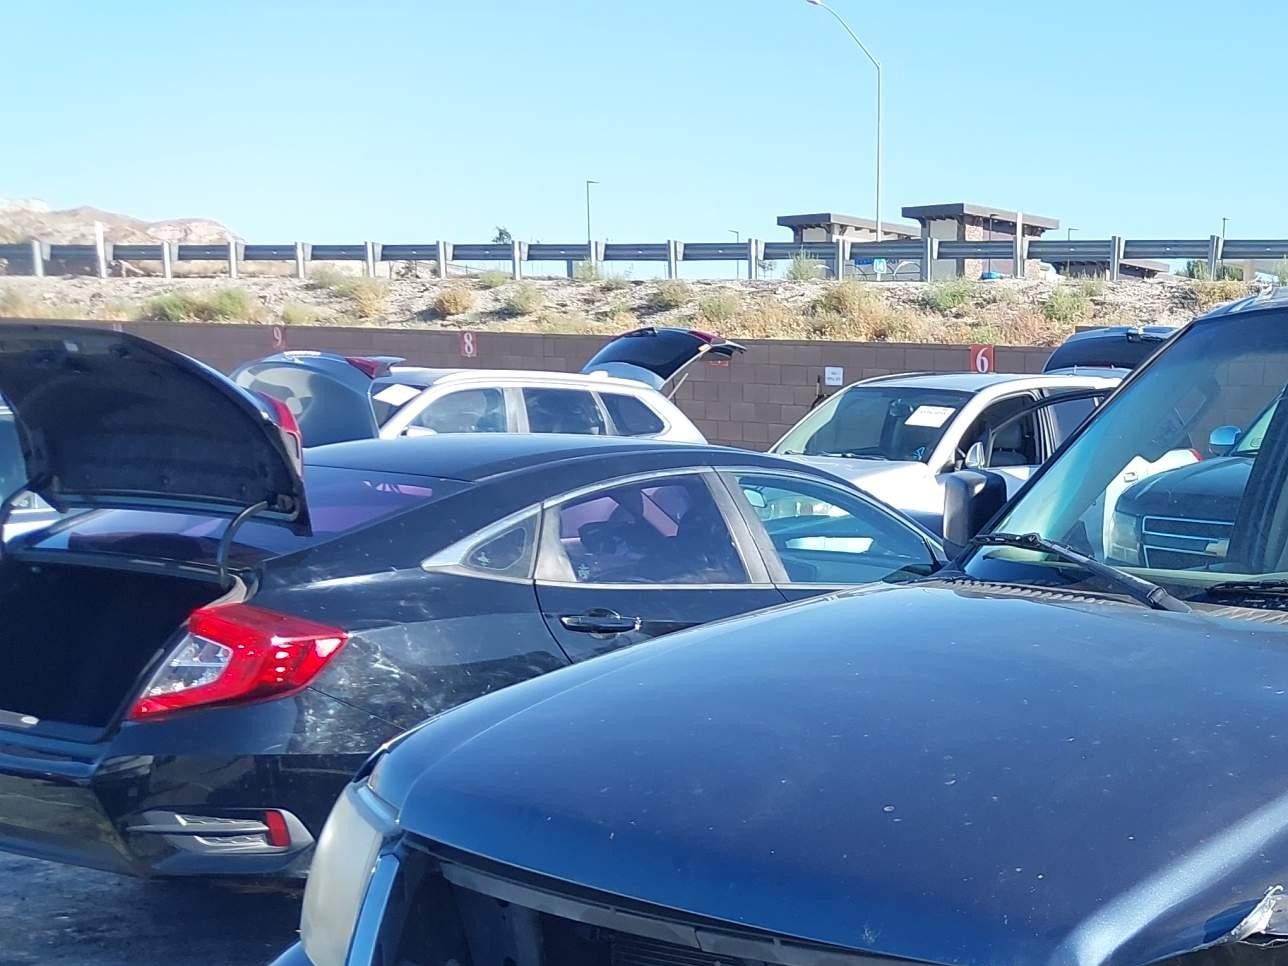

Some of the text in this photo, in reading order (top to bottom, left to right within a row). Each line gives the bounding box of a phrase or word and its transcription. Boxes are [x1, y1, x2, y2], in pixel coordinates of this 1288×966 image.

[273, 326, 282, 346] 9
[464, 332, 474, 353] 8
[976, 347, 989, 373] 6
